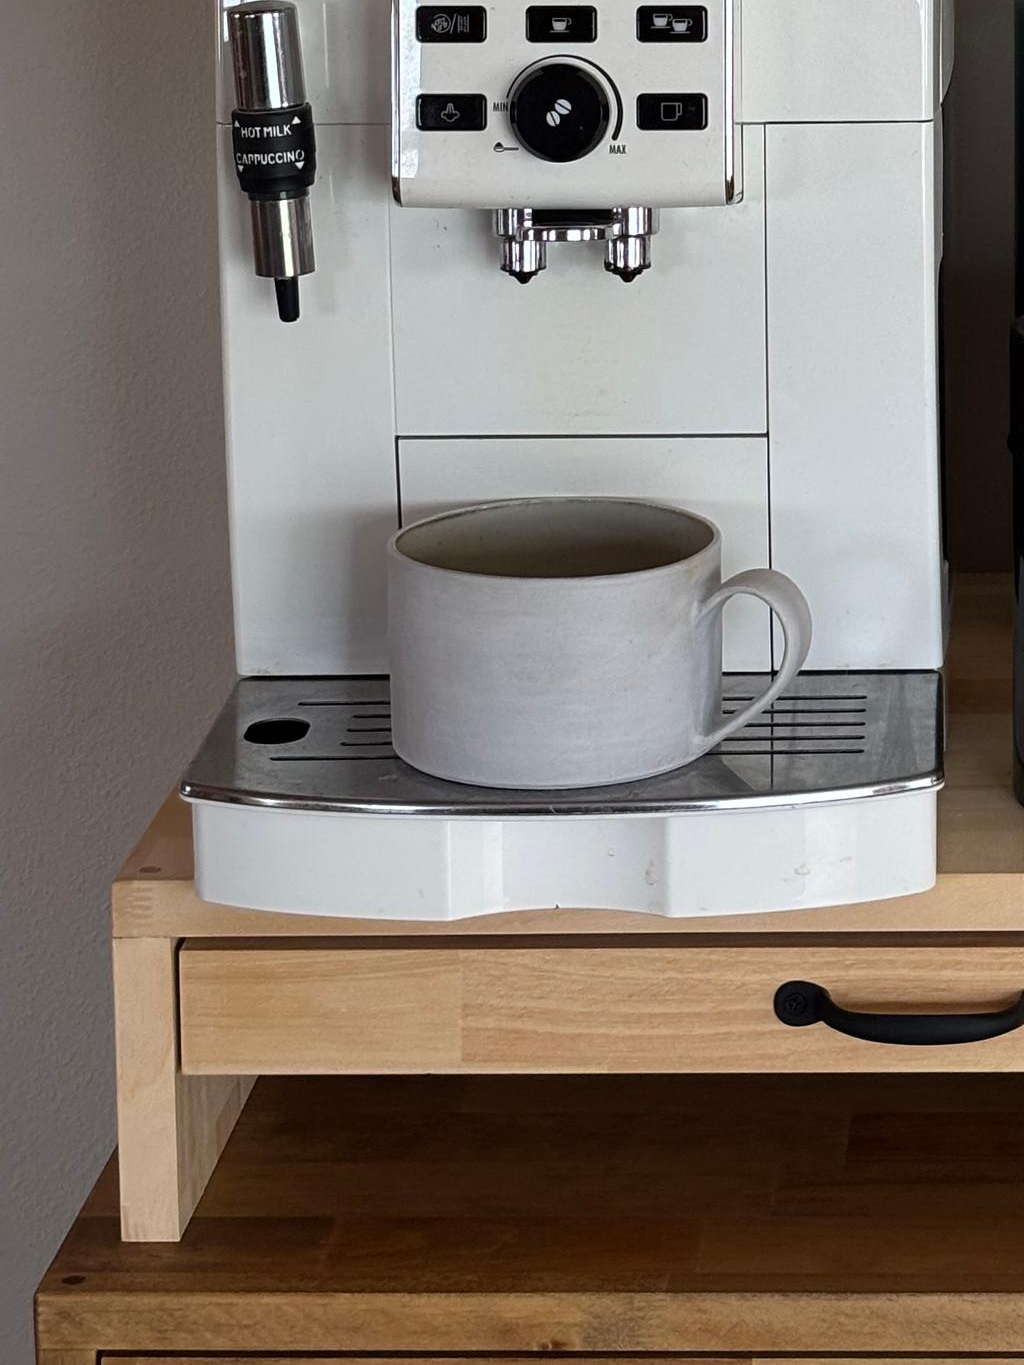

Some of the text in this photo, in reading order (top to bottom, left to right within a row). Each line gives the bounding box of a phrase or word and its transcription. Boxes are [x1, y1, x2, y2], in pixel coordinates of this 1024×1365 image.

[492, 101, 509, 113] MIN
[240, 123, 292, 139] HOT MILK
[608, 144, 627, 155] MAX
[235, 148, 305, 166] CAPPUCCINO
